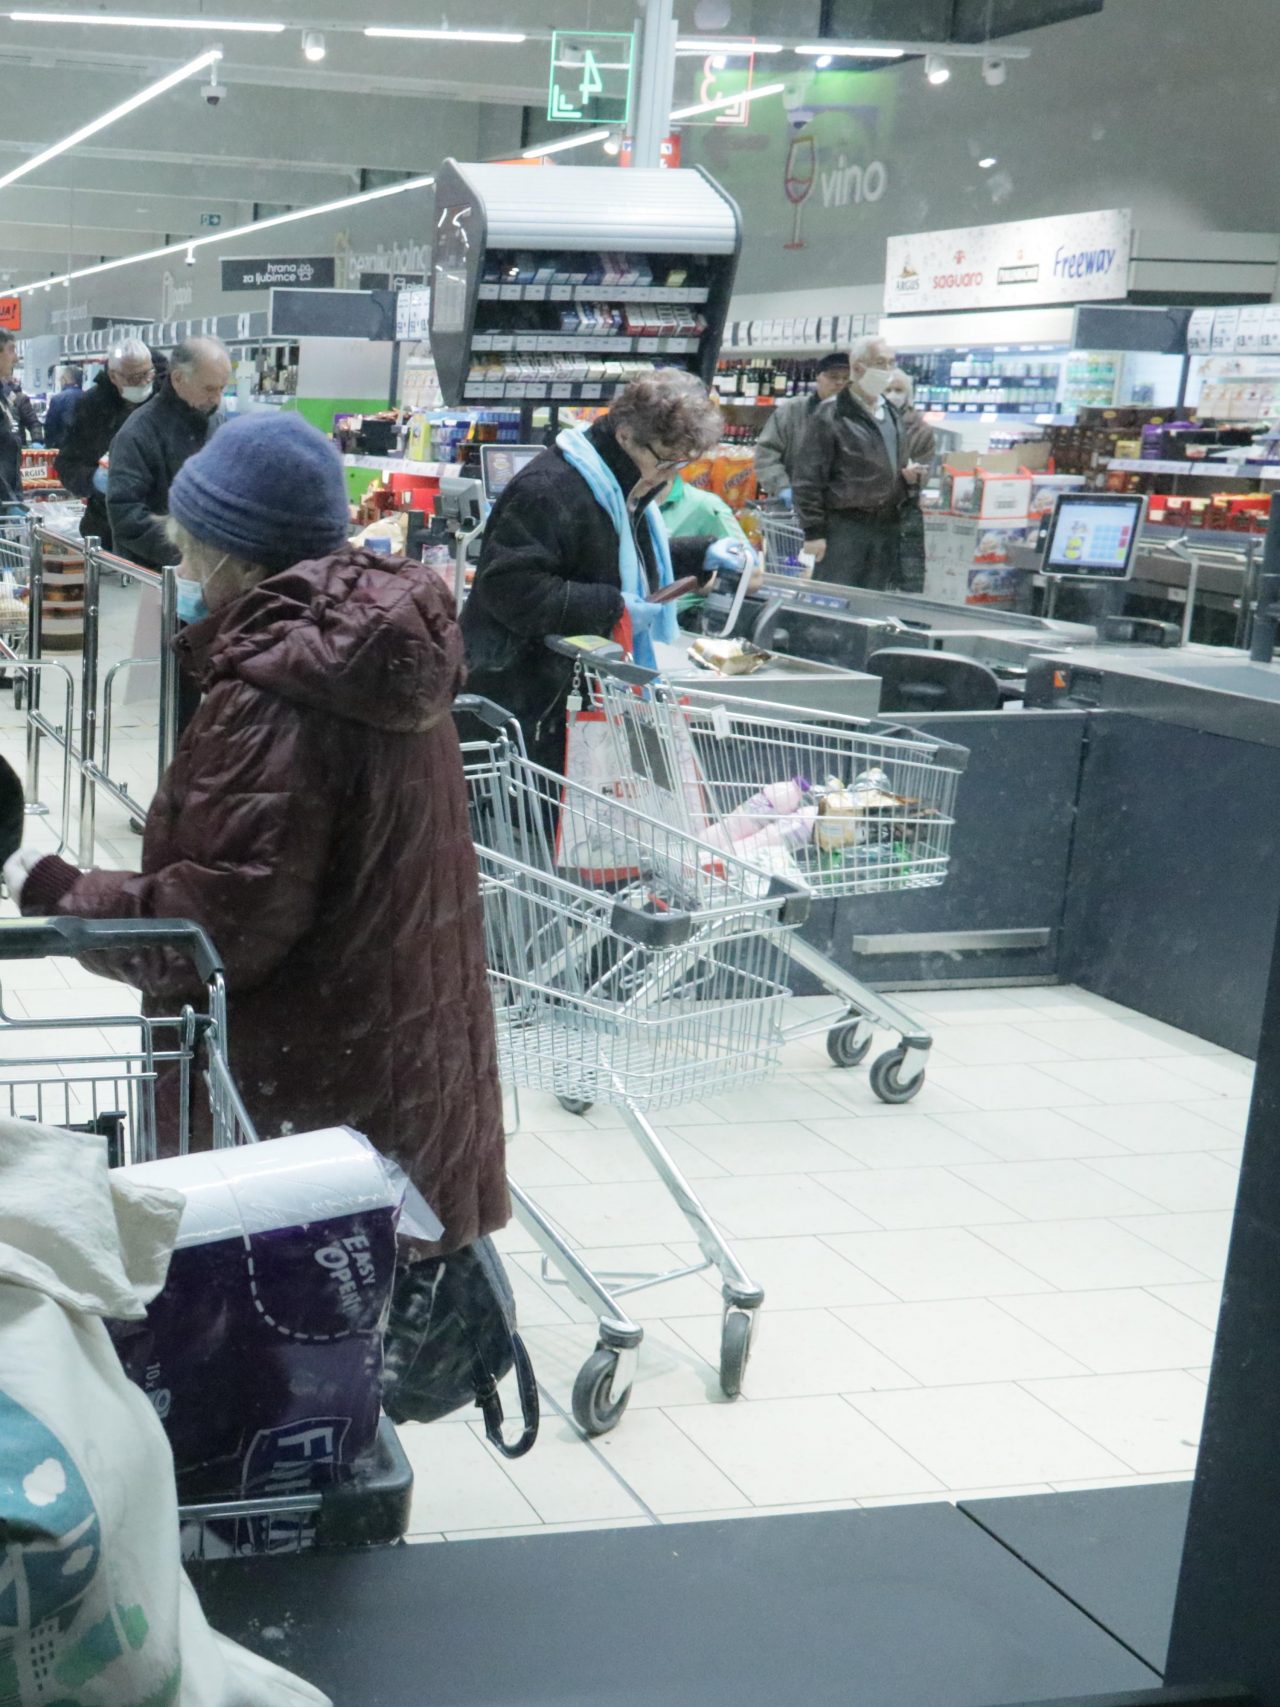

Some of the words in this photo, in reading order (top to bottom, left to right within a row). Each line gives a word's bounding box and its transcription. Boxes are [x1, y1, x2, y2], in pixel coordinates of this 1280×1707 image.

[821, 155, 887, 207] vino
[242, 274, 254, 283] za
[267, 262, 297, 273] hrana
[1052, 246, 1117, 280] Freeway
[314, 1247, 362, 1314] OPEN
[341, 1235, 376, 1286] EASY
